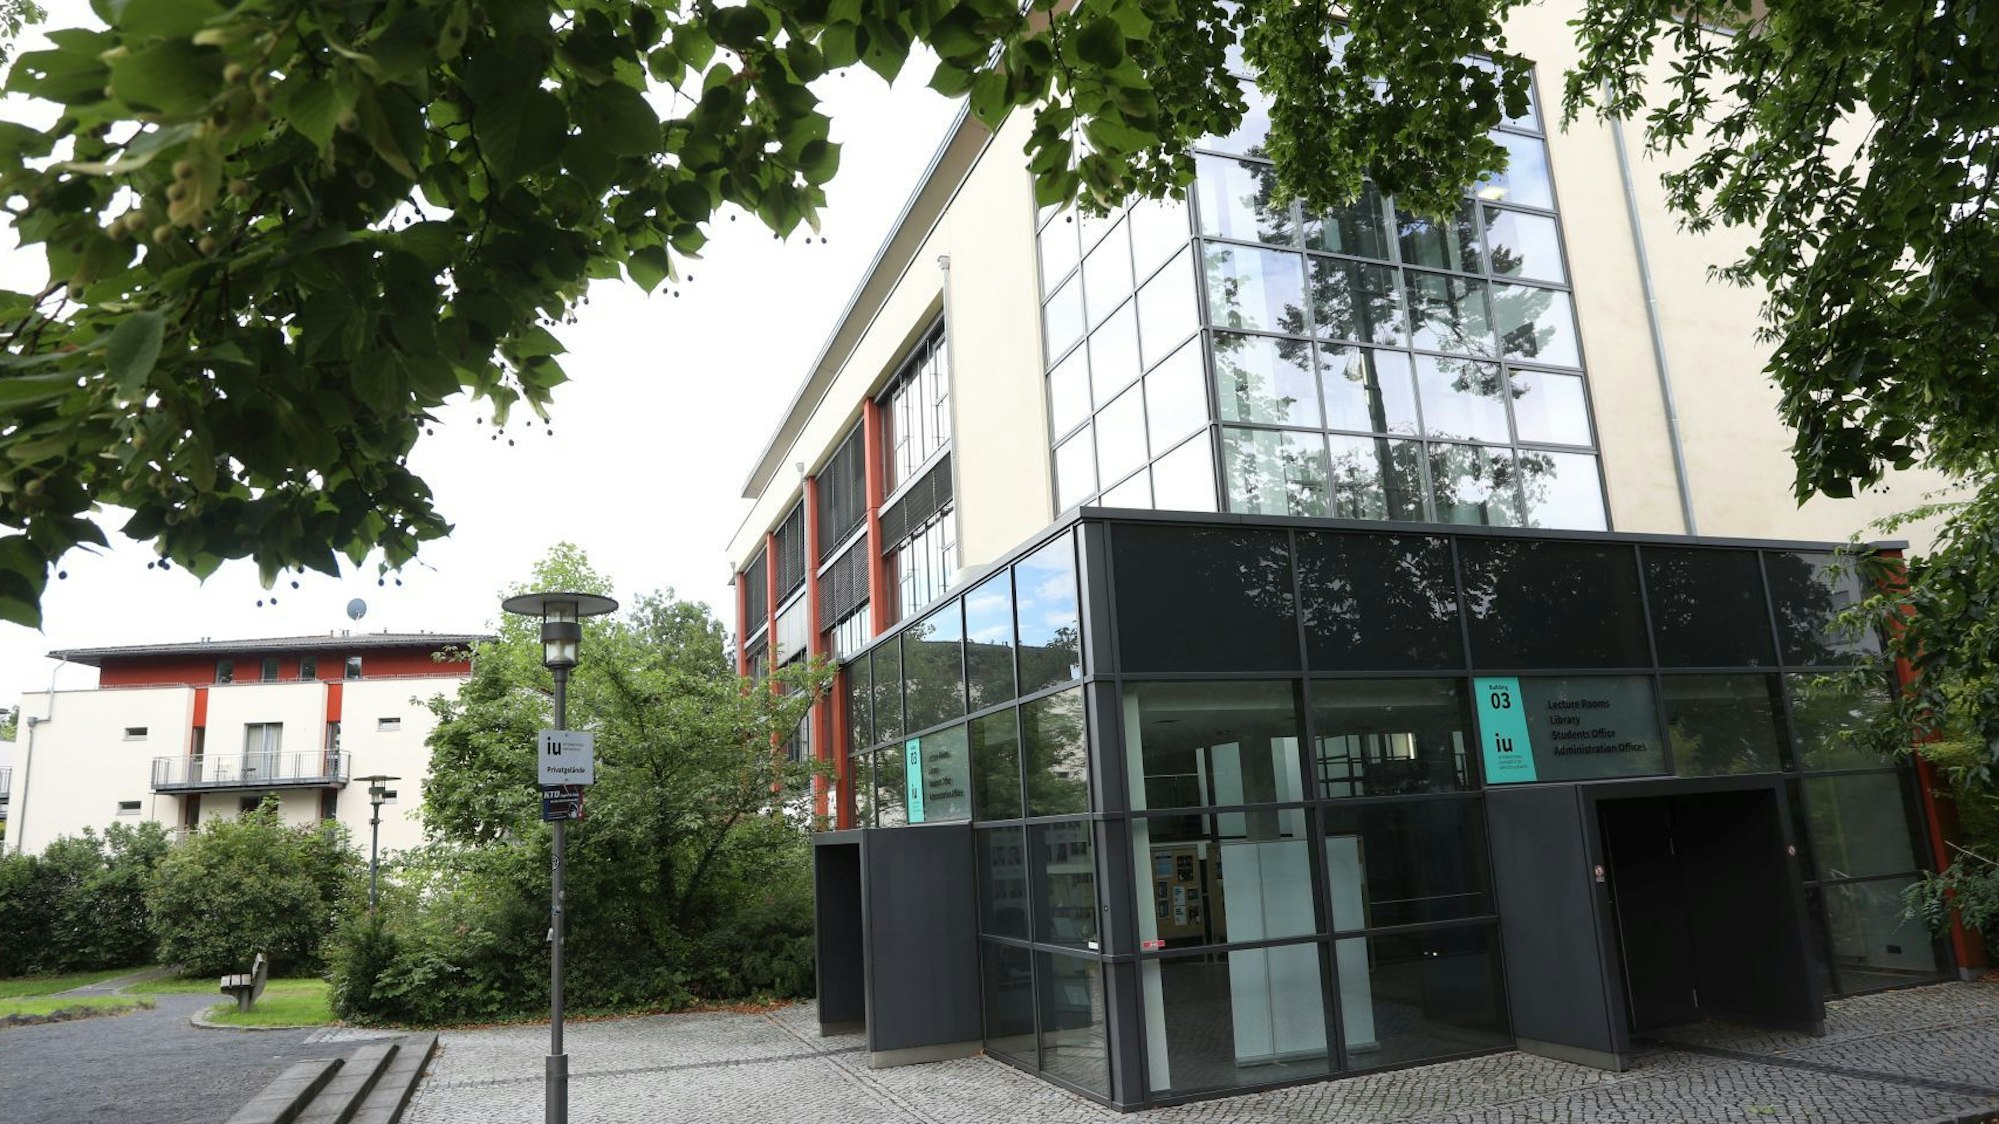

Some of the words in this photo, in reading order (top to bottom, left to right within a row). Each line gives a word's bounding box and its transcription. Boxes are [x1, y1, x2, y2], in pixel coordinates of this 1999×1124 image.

[1491, 692, 1511, 709] 03
[1547, 700, 1580, 710] Lecture
[1581, 699, 1611, 710] Rooms
[1549, 715, 1581, 726] Library
[1551, 729, 1590, 740] Students
[1591, 727, 1617, 738] Office
[547, 736, 561, 756] iu
[1495, 733, 1513, 752] iu
[1554, 743, 1618, 756] Administration
[1618, 741, 1648, 753] Offices
[547, 766, 586, 775] Privatgelände
